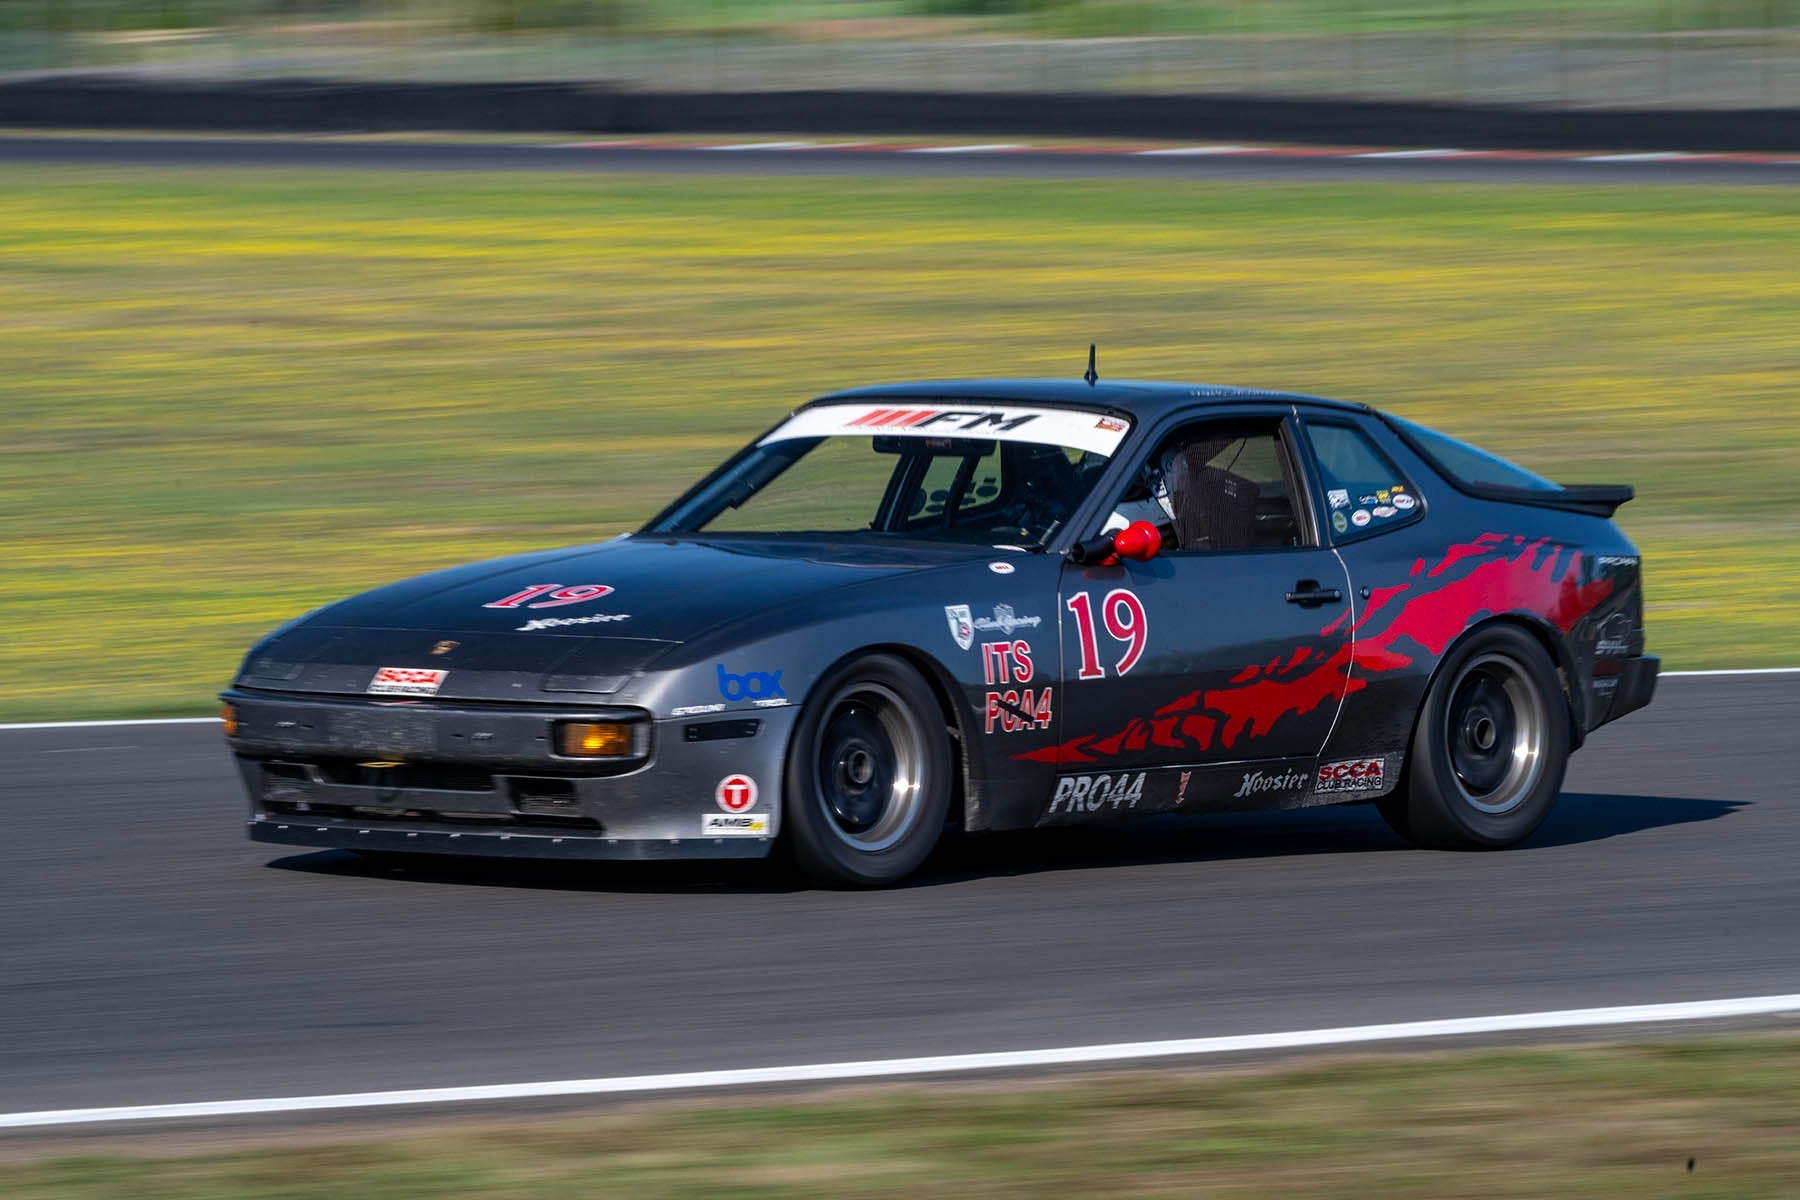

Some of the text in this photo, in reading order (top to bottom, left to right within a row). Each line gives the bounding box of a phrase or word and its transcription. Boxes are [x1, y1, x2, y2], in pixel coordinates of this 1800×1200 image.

[481, 584, 616, 609] 19
[1066, 588, 1148, 680] 19
[981, 640, 1034, 685] ITS
[716, 664, 785, 702] box
[985, 686, 1053, 734] PCA4
[1234, 768, 1310, 798] Hoosier
[1317, 776, 1381, 791] CLUB RACING
[1319, 761, 1381, 780] SCCA
[1048, 772, 1148, 815] PRO44
